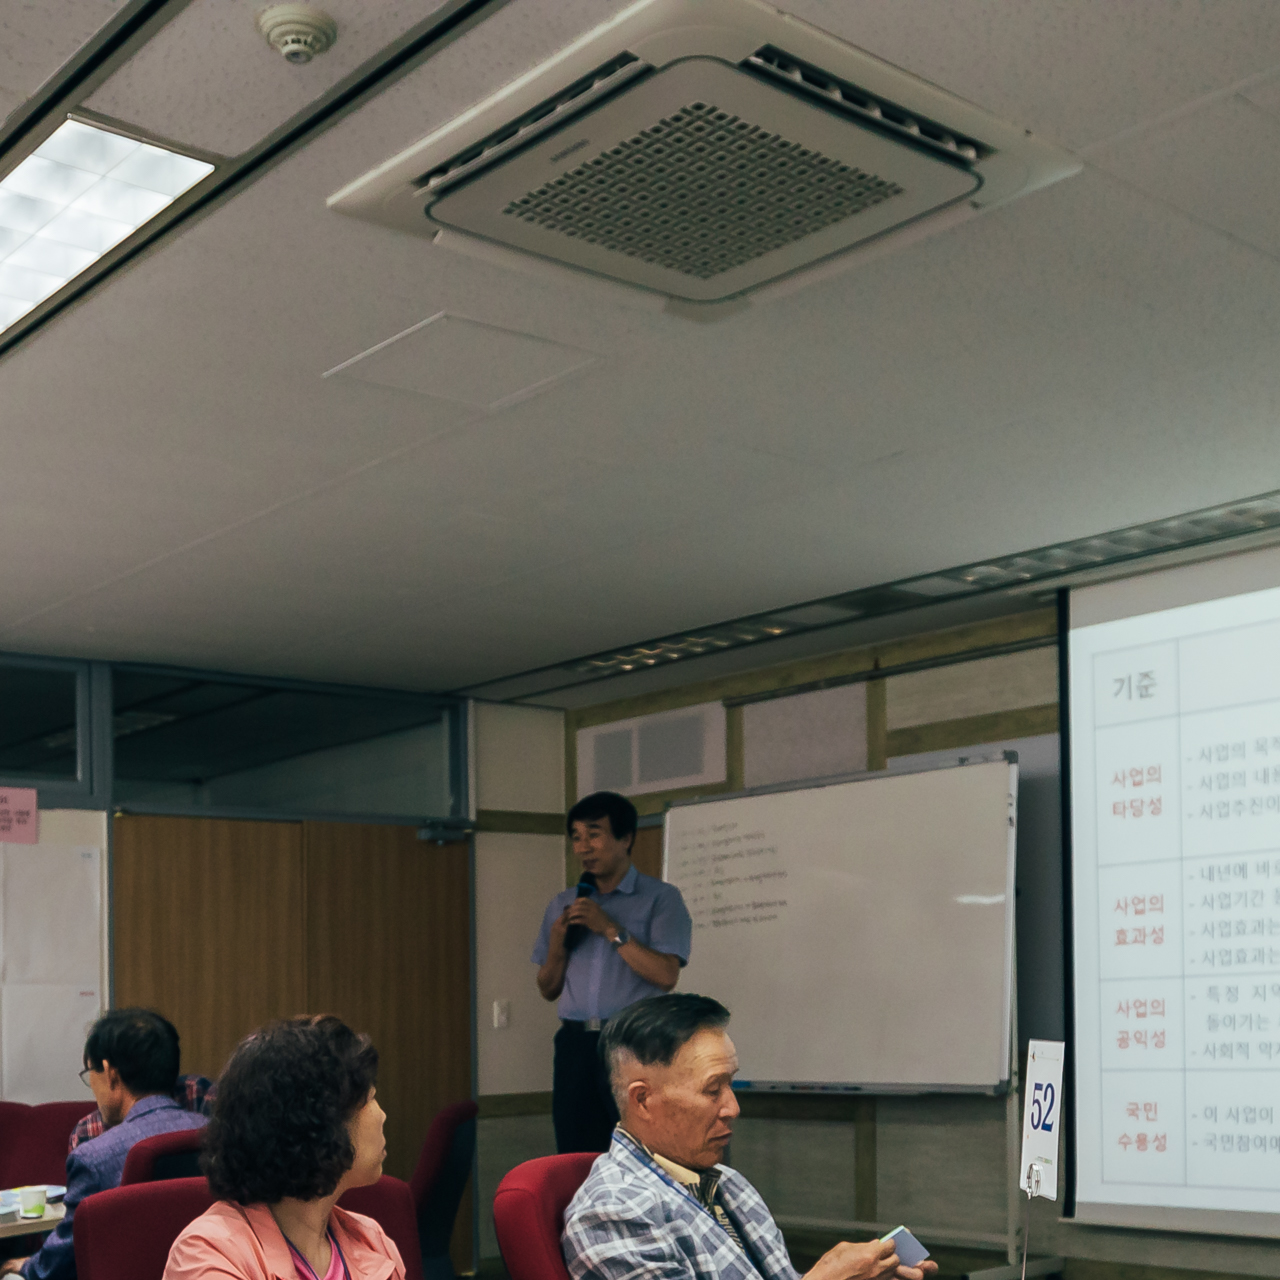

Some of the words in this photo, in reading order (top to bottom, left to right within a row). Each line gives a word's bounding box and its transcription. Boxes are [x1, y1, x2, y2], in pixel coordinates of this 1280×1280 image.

[1113, 670, 1157, 700] 기준
[1113, 765, 1162, 788] 사업의
[1113, 796, 1162, 820] 타당성
[1114, 893, 1165, 916] 사업의
[1114, 925, 1165, 947] 효과성
[1117, 998, 1166, 1019] 사업의
[1117, 1029, 1166, 1050] 공익성
[1030, 1082, 1055, 1132] 52
[1126, 1102, 1159, 1122] 국민
[1118, 1132, 1168, 1153] 수용성
